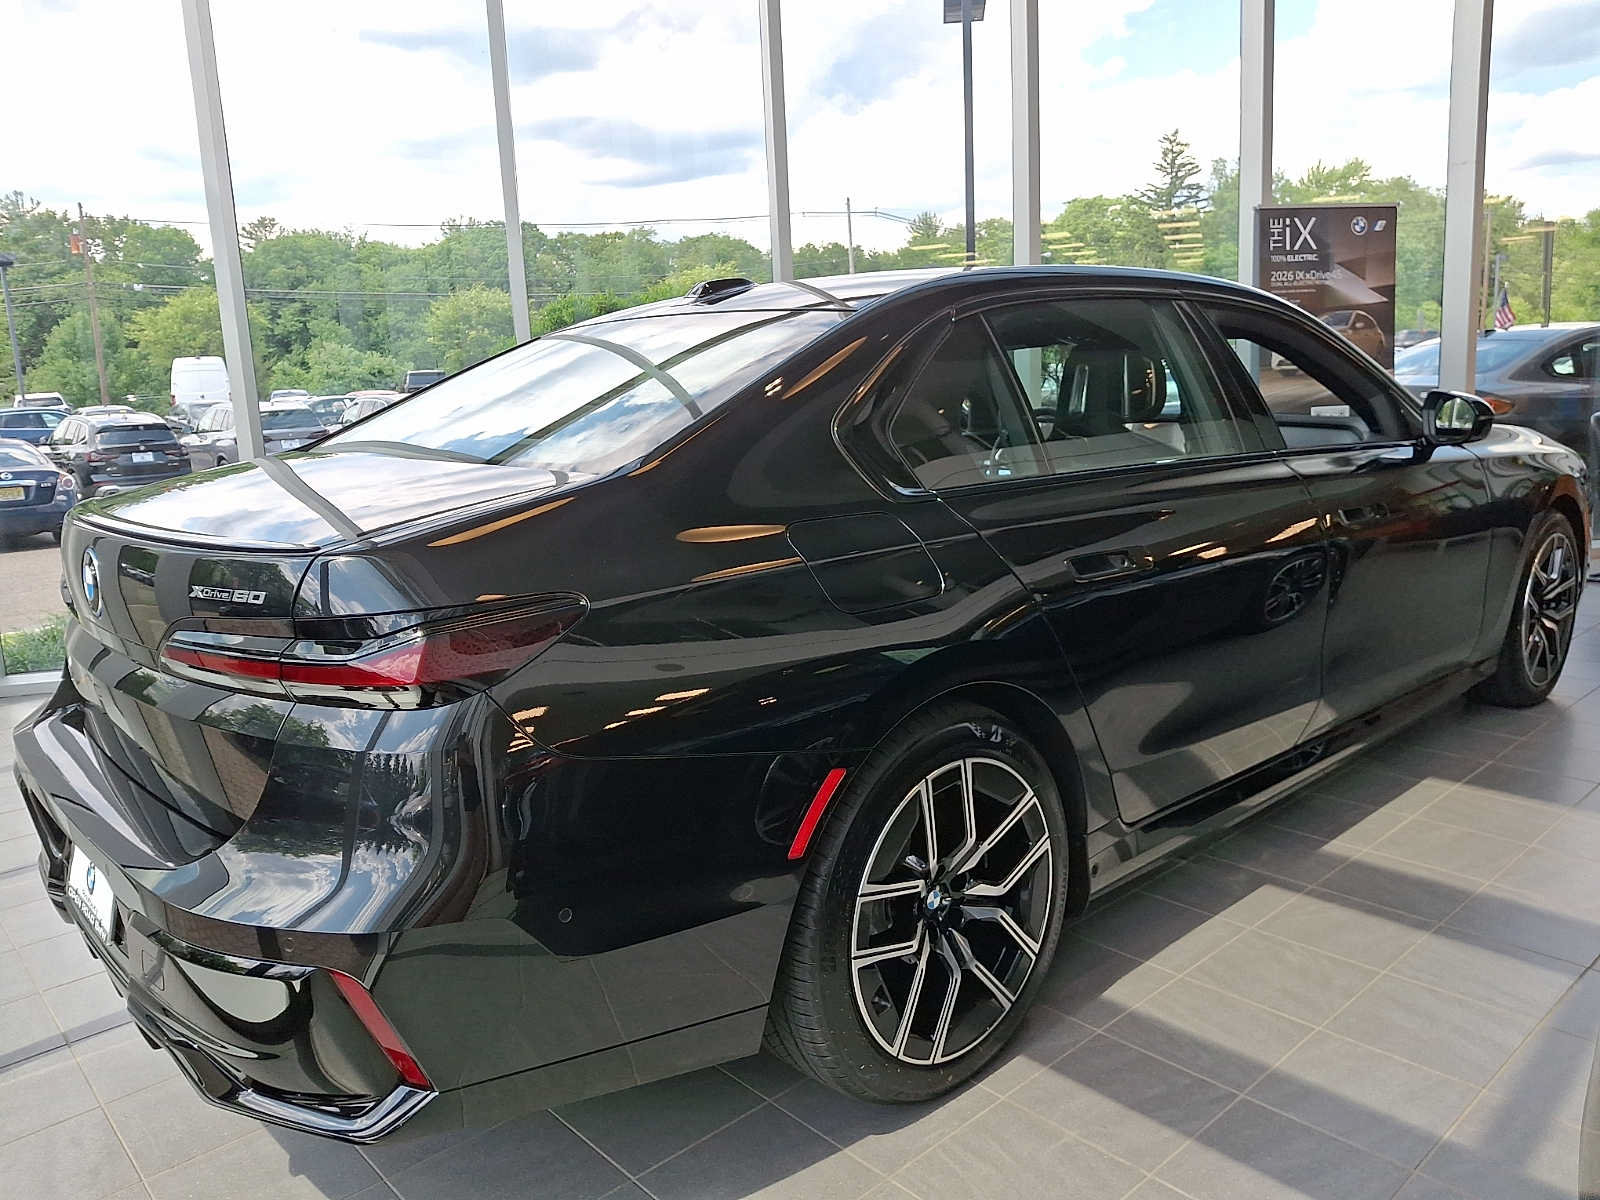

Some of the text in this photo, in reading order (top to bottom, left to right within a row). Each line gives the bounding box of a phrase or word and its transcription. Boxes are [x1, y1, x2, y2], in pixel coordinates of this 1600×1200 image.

[1270, 217, 1318, 251] THE iX
[1270, 270, 1294, 282] 2026
[232, 589, 267, 605] 60
